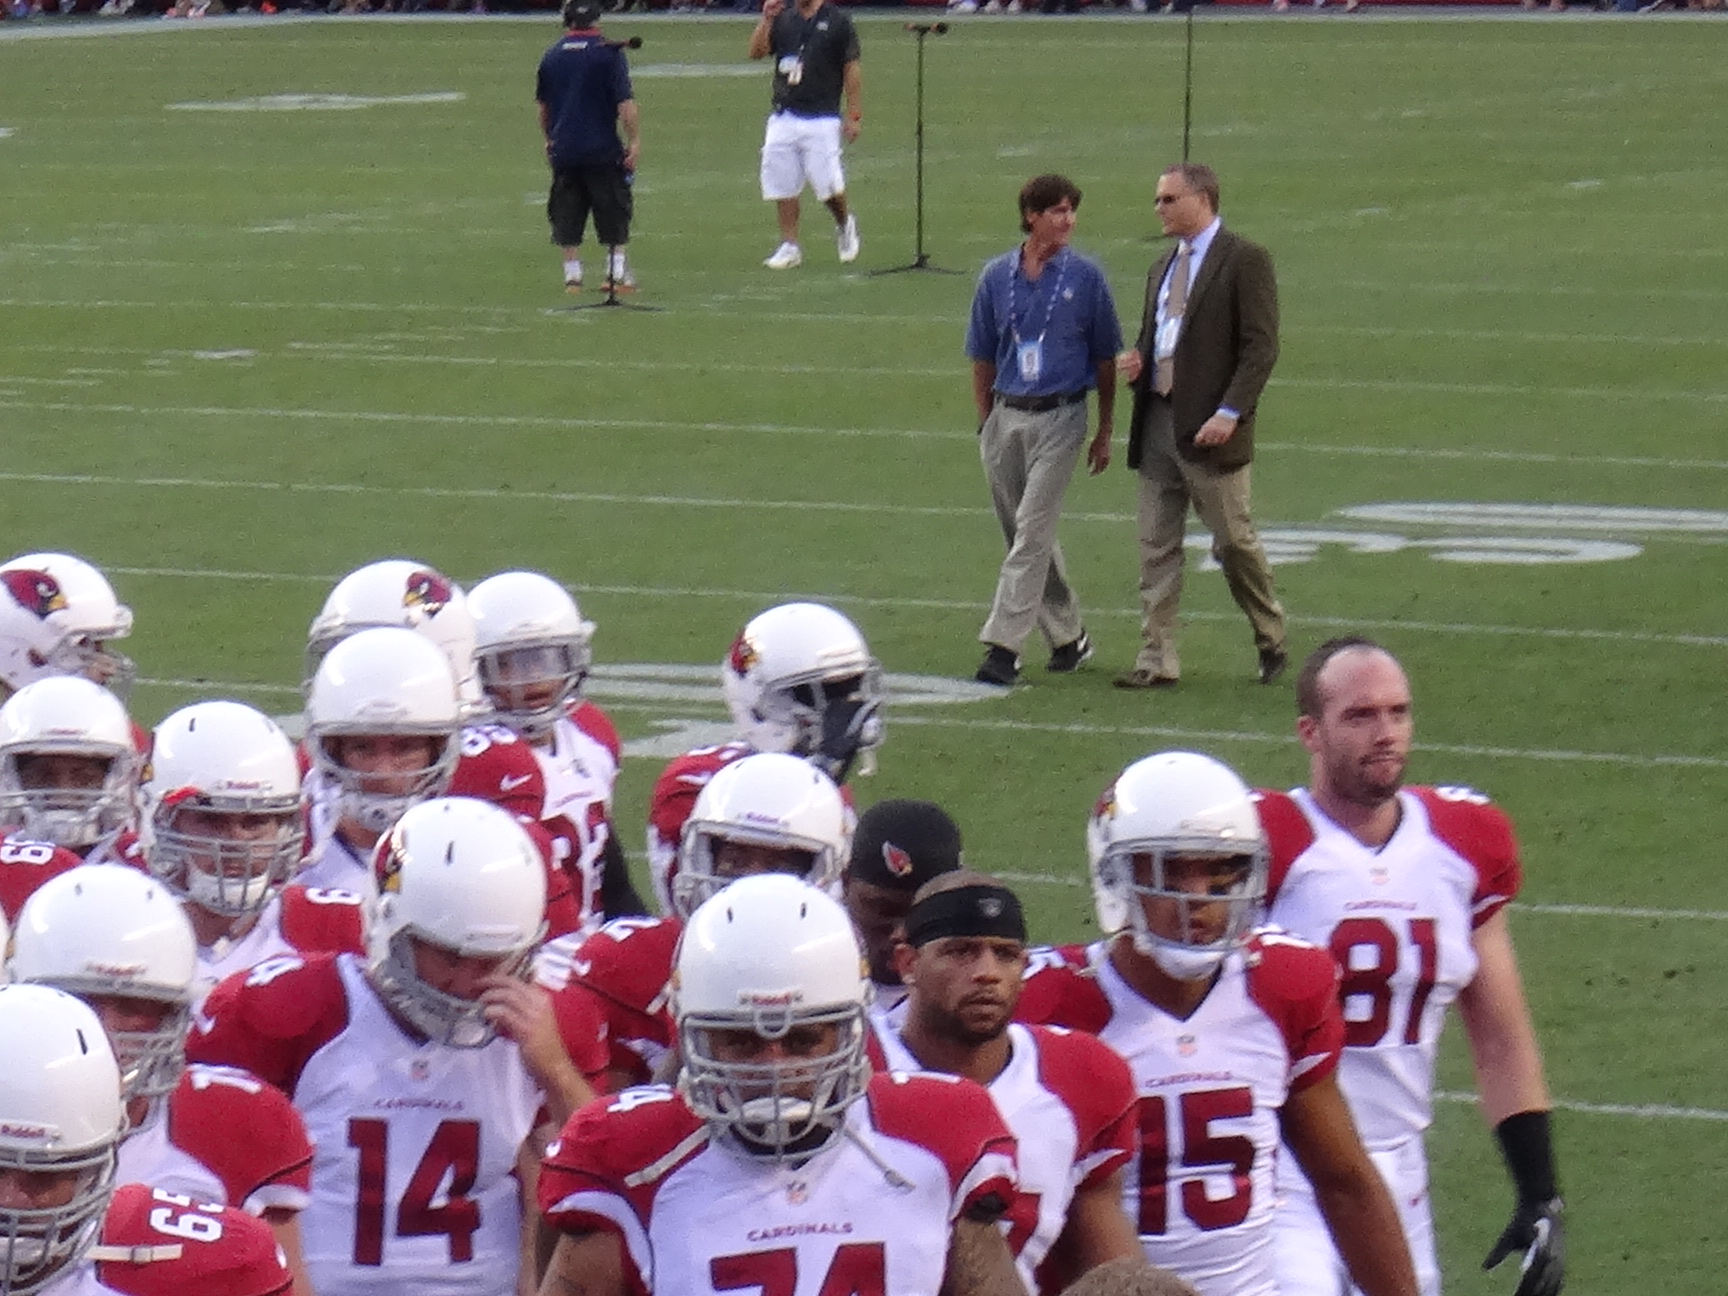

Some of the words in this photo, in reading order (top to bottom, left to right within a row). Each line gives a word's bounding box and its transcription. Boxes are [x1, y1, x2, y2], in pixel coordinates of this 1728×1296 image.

[1329, 917, 1438, 1049] 81
[348, 1117, 481, 1266] 14
[1137, 1086, 1256, 1234] 15
[746, 1222, 854, 1241] CARDINALS
